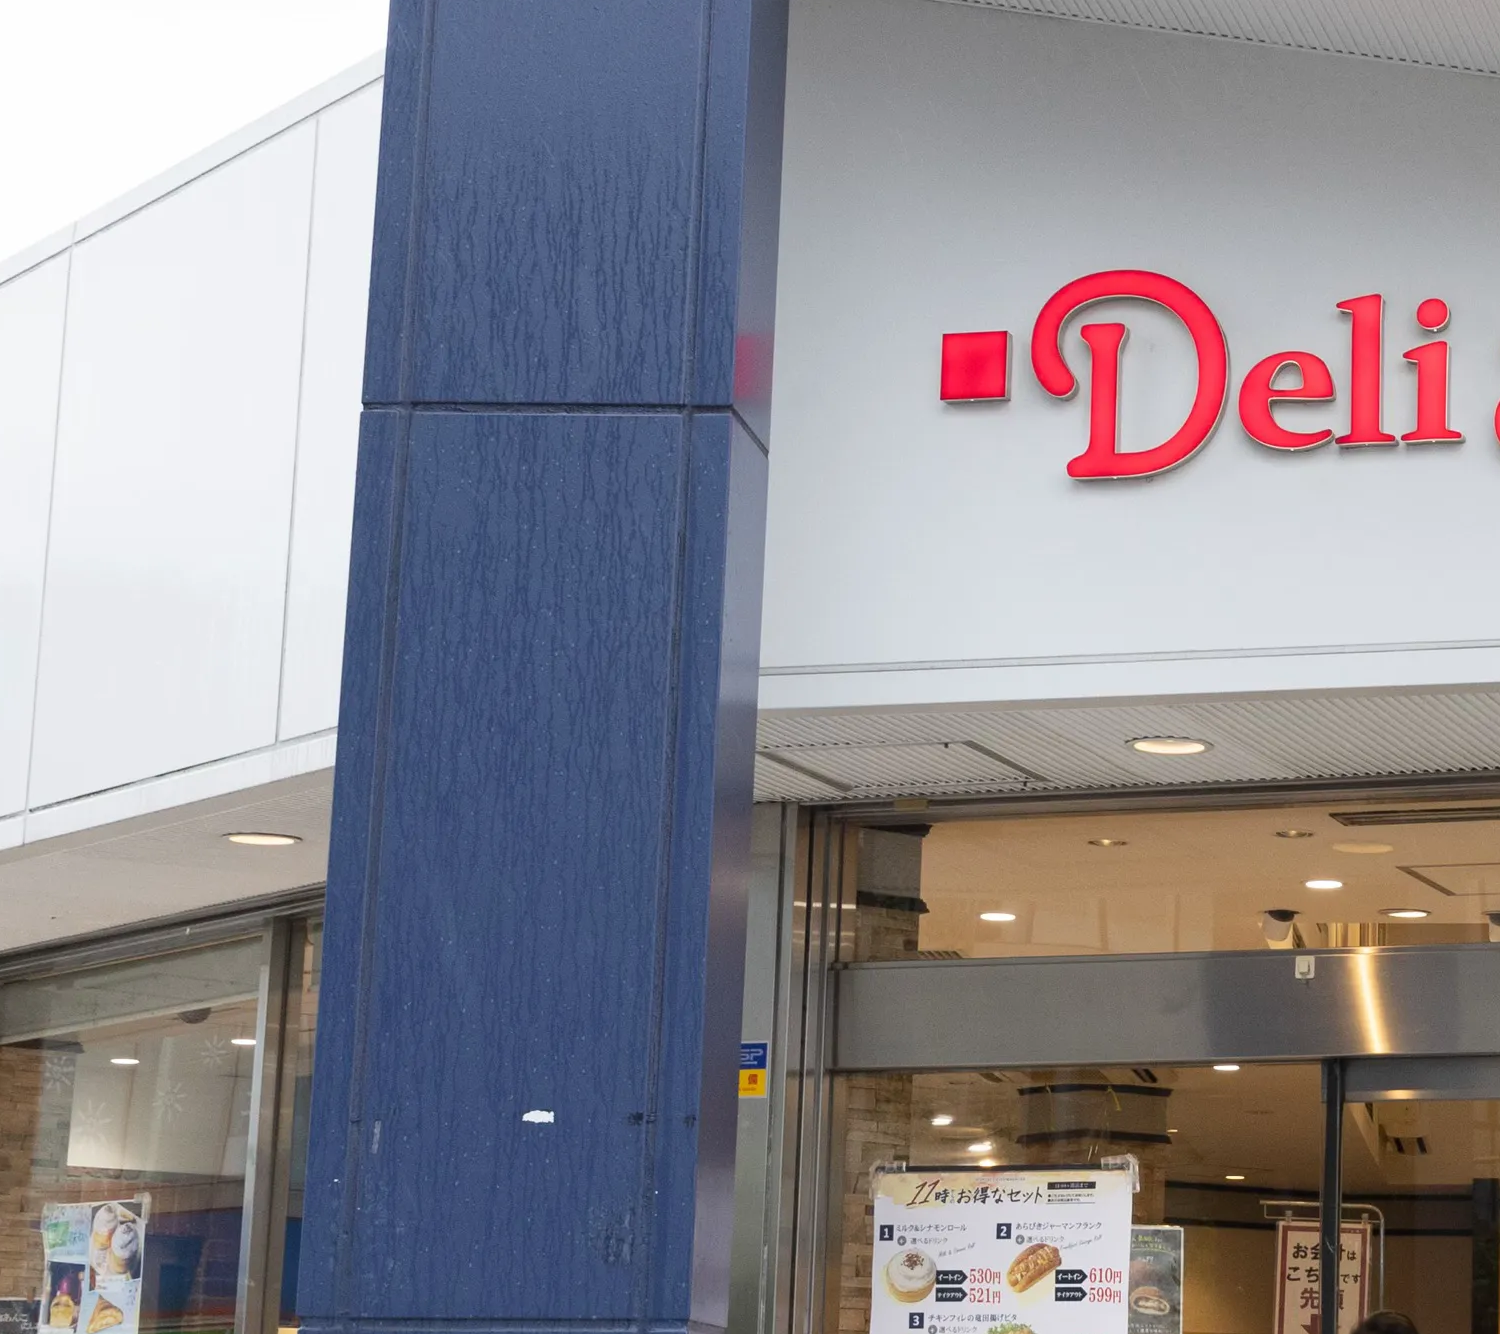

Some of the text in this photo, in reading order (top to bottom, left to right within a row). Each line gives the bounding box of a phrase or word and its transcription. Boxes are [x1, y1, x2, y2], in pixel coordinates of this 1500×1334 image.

[1031, 268, 1464, 481] Deli
[896, 1223, 968, 1233] ミルク&シナモンロール
[1015, 1221, 1102, 1231] あらびきジャーマンフランク
[910, 1236, 948, 1245] 選べるドリンク
[1026, 1235, 1065, 1244] 選べるドリンク
[938, 1268, 1001, 1285] イートイン 530円
[1056, 1268, 1122, 1284] イートイン 610円
[937, 1287, 1001, 1304] テイクアウト 521円
[1056, 1287, 1122, 1303] テイクアウト 599円
[927, 1313, 1018, 1323] チキンフィレの竜田揚げピタ
[938, 1325, 978, 1334] 選べるドリンク
